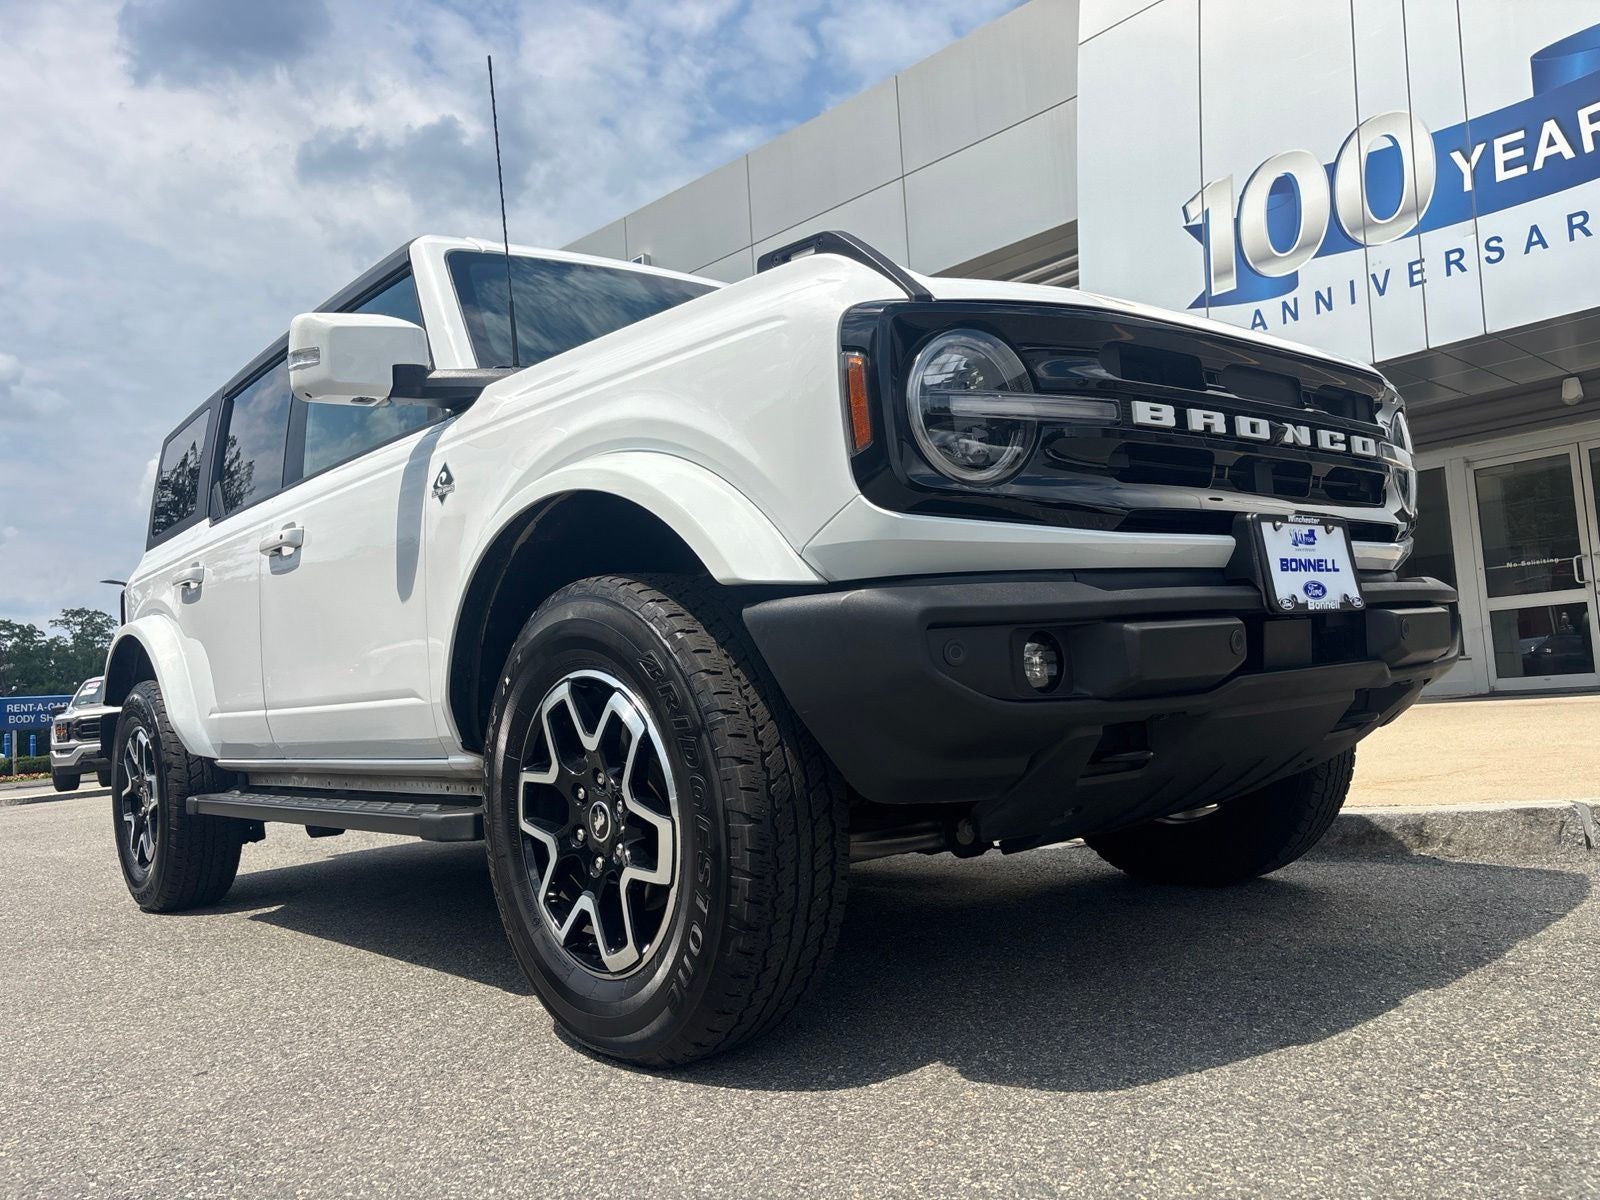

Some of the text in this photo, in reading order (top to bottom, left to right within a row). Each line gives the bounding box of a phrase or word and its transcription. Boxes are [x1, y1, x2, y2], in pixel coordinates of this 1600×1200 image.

[1183, 110, 1436, 296] 100
[1250, 209, 1592, 331] ANNIVERSAR
[1132, 400, 1377, 458] BRONCO
[1279, 558, 1340, 572] BONNELL
[1306, 583, 1324, 597] Ford
[1308, 600, 1340, 610] Bonnell
[8, 714, 36, 724] BODY
